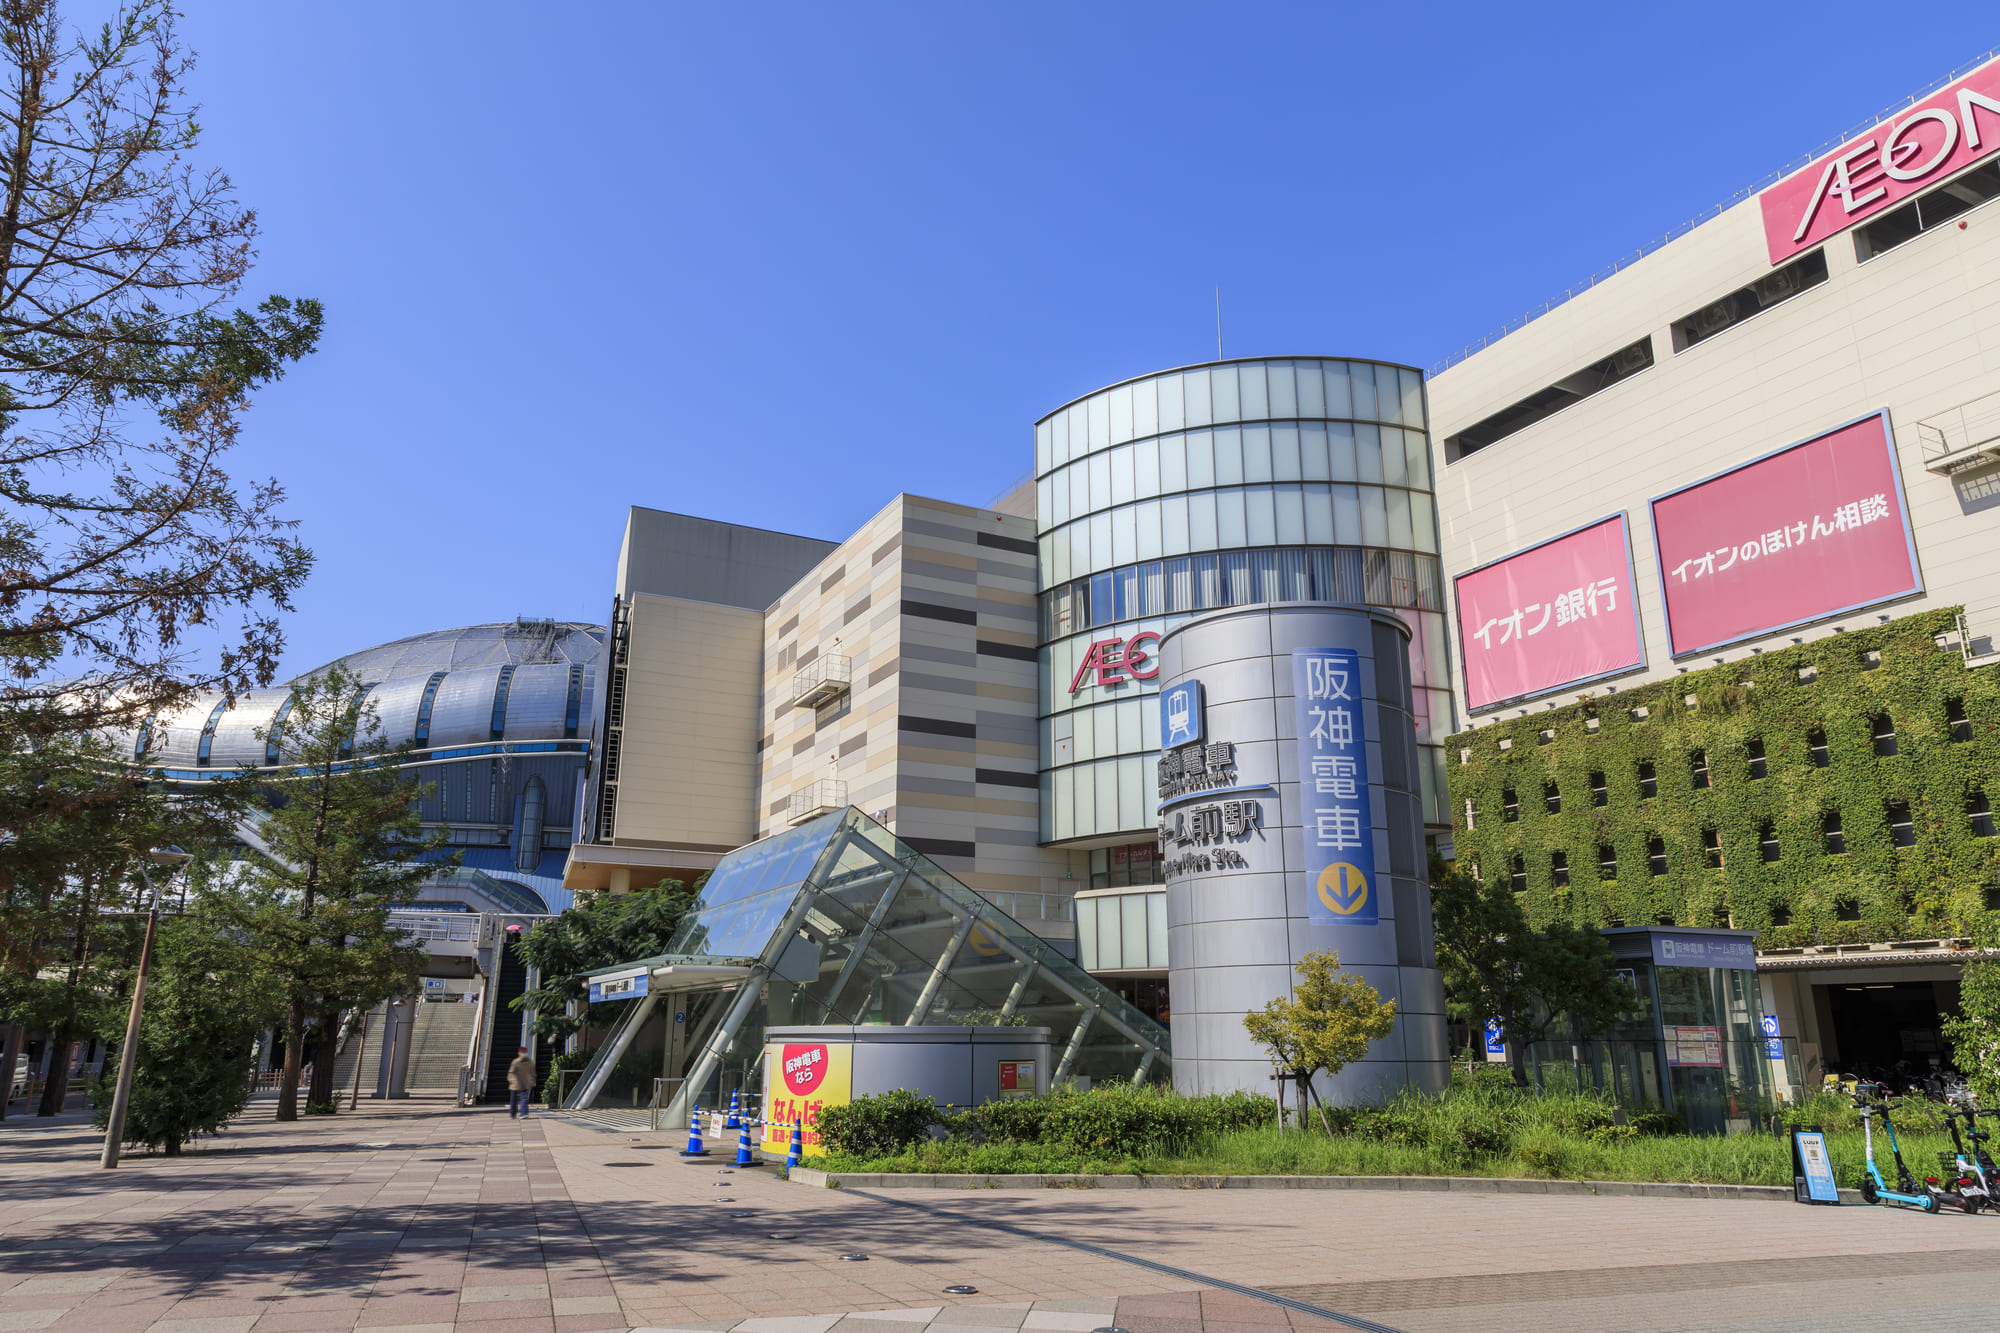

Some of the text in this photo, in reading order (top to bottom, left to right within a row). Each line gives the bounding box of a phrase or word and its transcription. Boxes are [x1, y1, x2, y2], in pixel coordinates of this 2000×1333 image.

[1672, 493, 1890, 583] イオンのほけん相談
[1473, 577, 1619, 649] イオン銀行
[1306, 657, 1362, 851] 阪神電車
[785, 1048, 822, 1075] 阪神電車
[795, 1068, 814, 1084] なら
[773, 1098, 823, 1125] なんば
